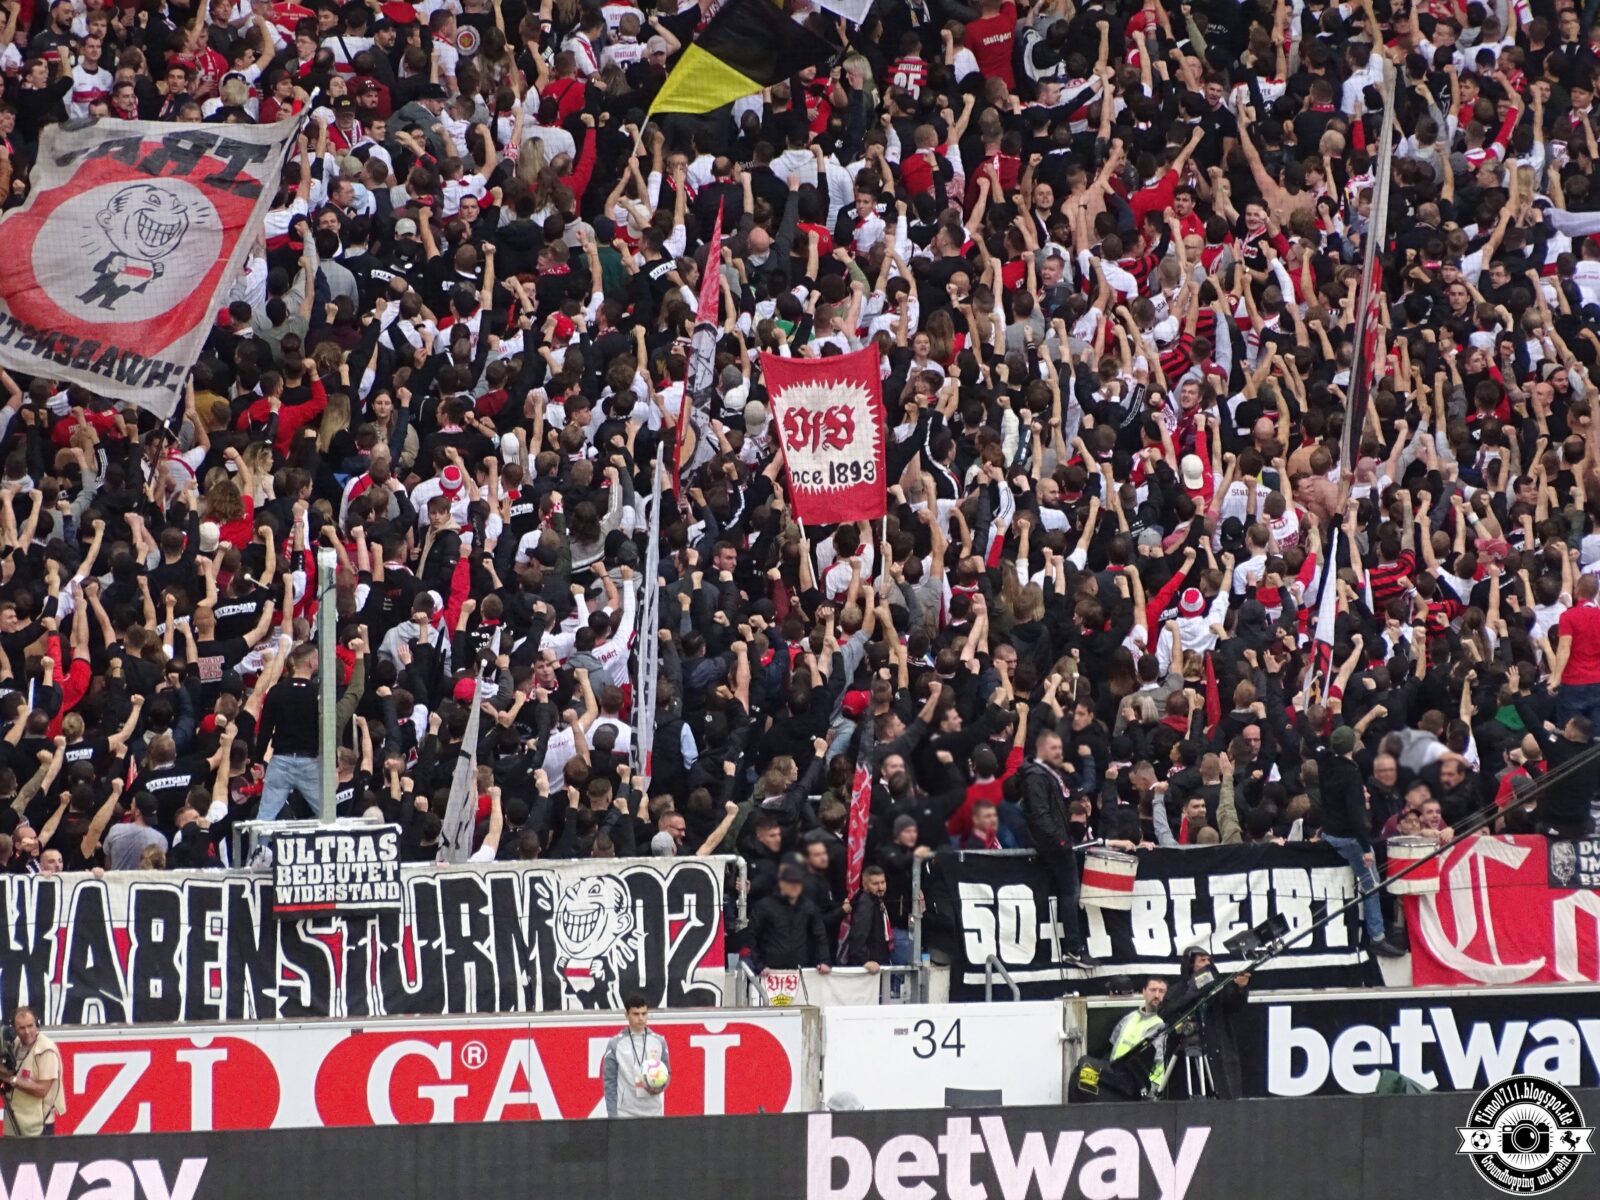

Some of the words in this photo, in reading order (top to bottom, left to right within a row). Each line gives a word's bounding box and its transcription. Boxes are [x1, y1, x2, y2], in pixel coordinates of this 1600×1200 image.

[783, 404, 856, 454] VfB
[828, 460, 876, 486] 1893
[146, 775, 191, 792] STUTTGART
[276, 832, 398, 865] ULTRAS
[276, 861, 398, 886] BEDEUTET
[275, 881, 400, 904] WIDERSTAND
[1130, 866, 1363, 958] BLEIBT
[911, 1018, 967, 1059] 34
[806, 1113, 1212, 1200] betway
